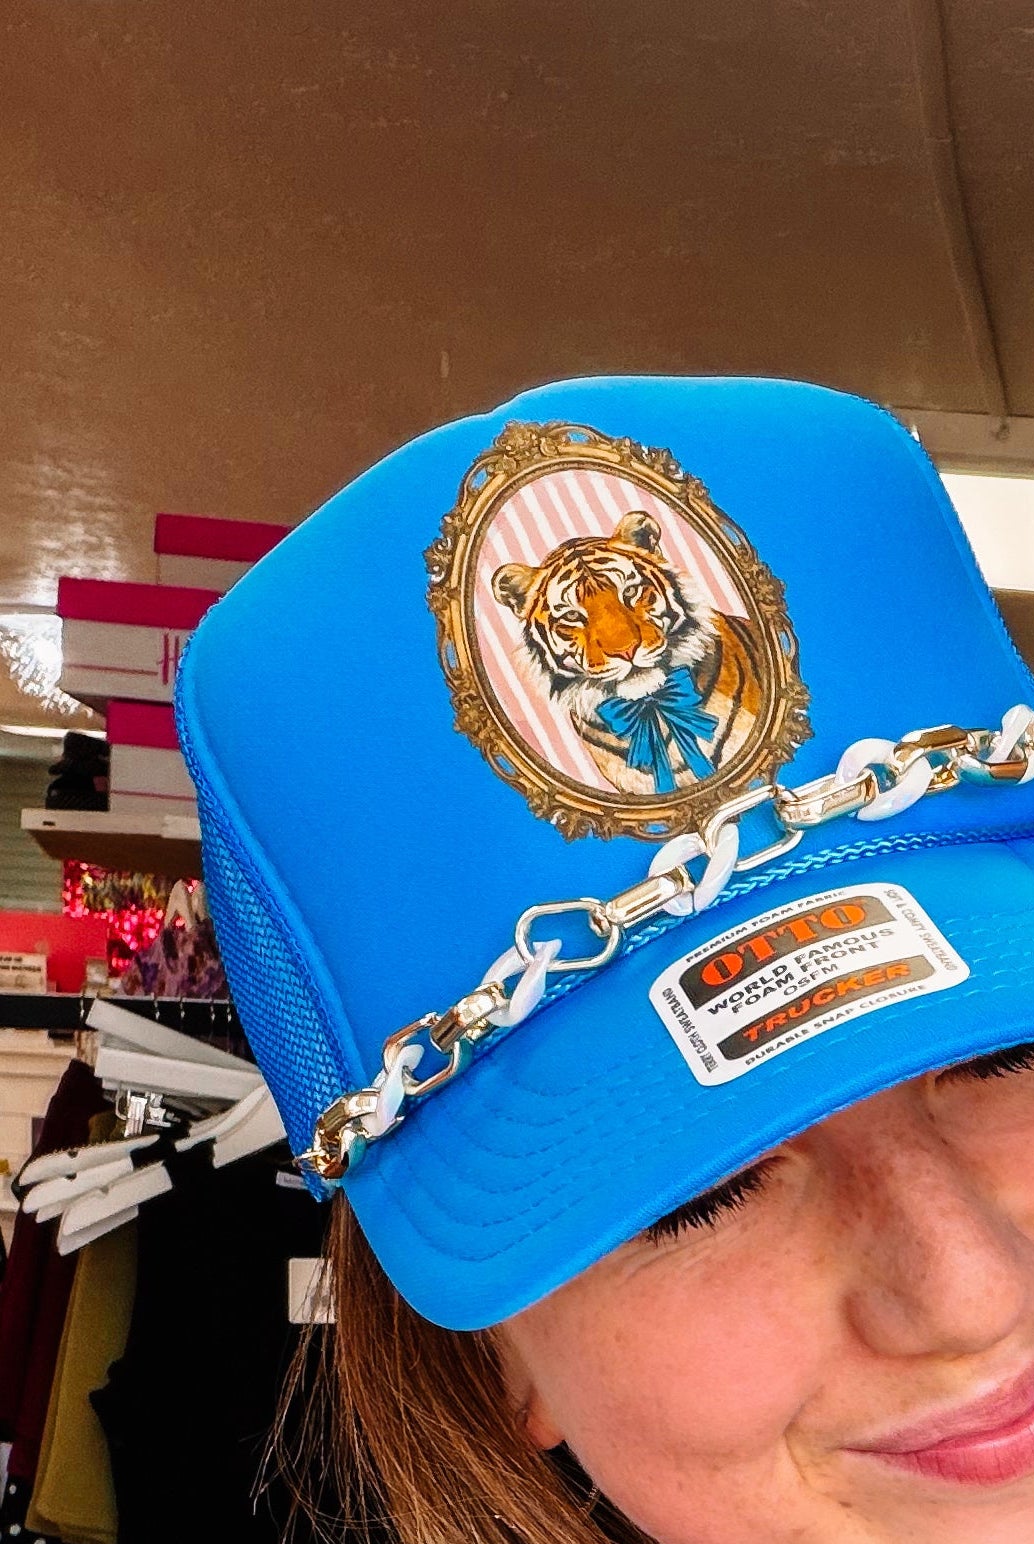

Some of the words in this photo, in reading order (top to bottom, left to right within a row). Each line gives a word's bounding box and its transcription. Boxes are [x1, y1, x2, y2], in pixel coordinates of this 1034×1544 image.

[686, 926, 748, 963] PREMIUM
[751, 907, 794, 927] FOAM
[797, 891, 846, 909] FABRIC
[700, 903, 867, 987] OTTO
[707, 964, 788, 1015] WORLD
[793, 928, 896, 965] FAMOUS
[731, 972, 796, 1014] FOAM
[800, 941, 882, 973] FRONT
[742, 962, 912, 1042] TRUCKER
[783, 963, 840, 997] OSFM
[744, 1028, 810, 1066] DURABLE
[813, 1008, 855, 1030] SNAP
[859, 984, 927, 1009] CLOSURE
